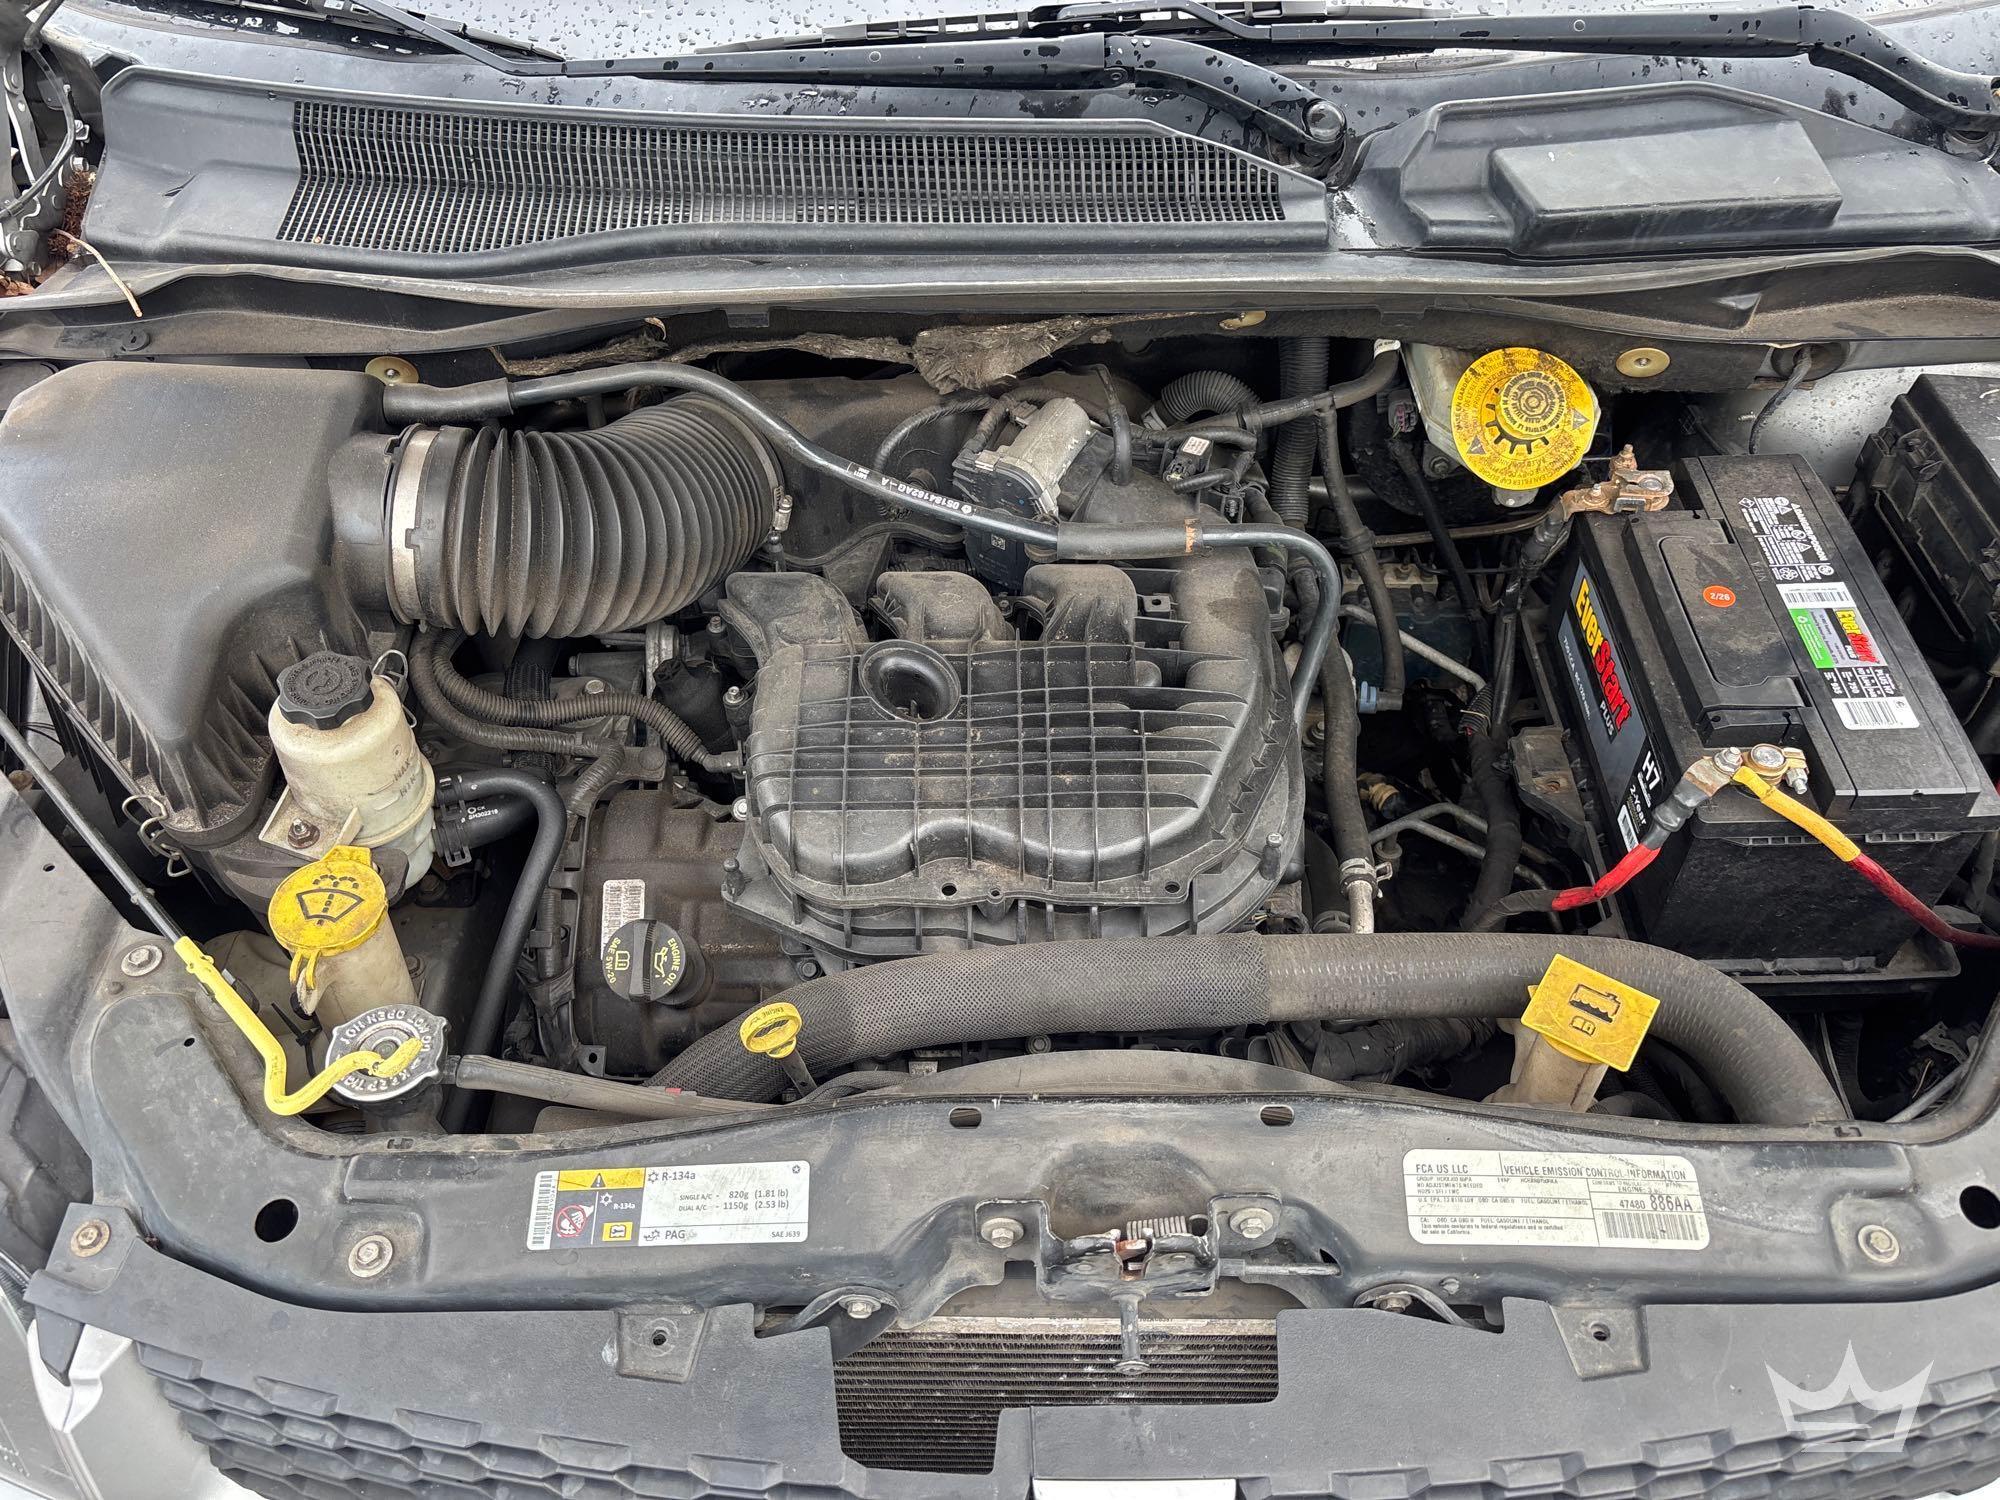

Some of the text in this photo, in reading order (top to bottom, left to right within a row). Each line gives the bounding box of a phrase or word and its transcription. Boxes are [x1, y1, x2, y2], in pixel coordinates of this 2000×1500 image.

[1835, 609, 1878, 663] EverStart
[1575, 578, 1631, 731] EverStart
[1874, 668, 1888, 684] PLUS
[1599, 700, 1615, 735] PLUS
[1642, 751, 1661, 790] H7
[1629, 785, 1647, 824] 2-Year
[605, 936, 621, 983] SAE 5W-20
[663, 937, 680, 986] ENGINE OIL
[365, 1009, 405, 1022] OPEN
[406, 1014, 429, 1034] NOT
[339, 1020, 365, 1044] HOT
[662, 1171, 696, 1180] R-134a
[1416, 1164, 1686, 1180] FCA US LLC VEHICLE EMISSION CONTROL INFORMATION
[729, 1190, 749, 1199] 820g
[754, 1190, 775, 1199] (1.81
[778, 1189, 788, 1198] lb)
[1619, 1194, 1692, 1211] 47480 886AA
[723, 1202, 748, 1210] 1150g
[754, 1200, 776, 1210] (2.53
[778, 1200, 789, 1209] lb)
[665, 1230, 685, 1239] PAG
